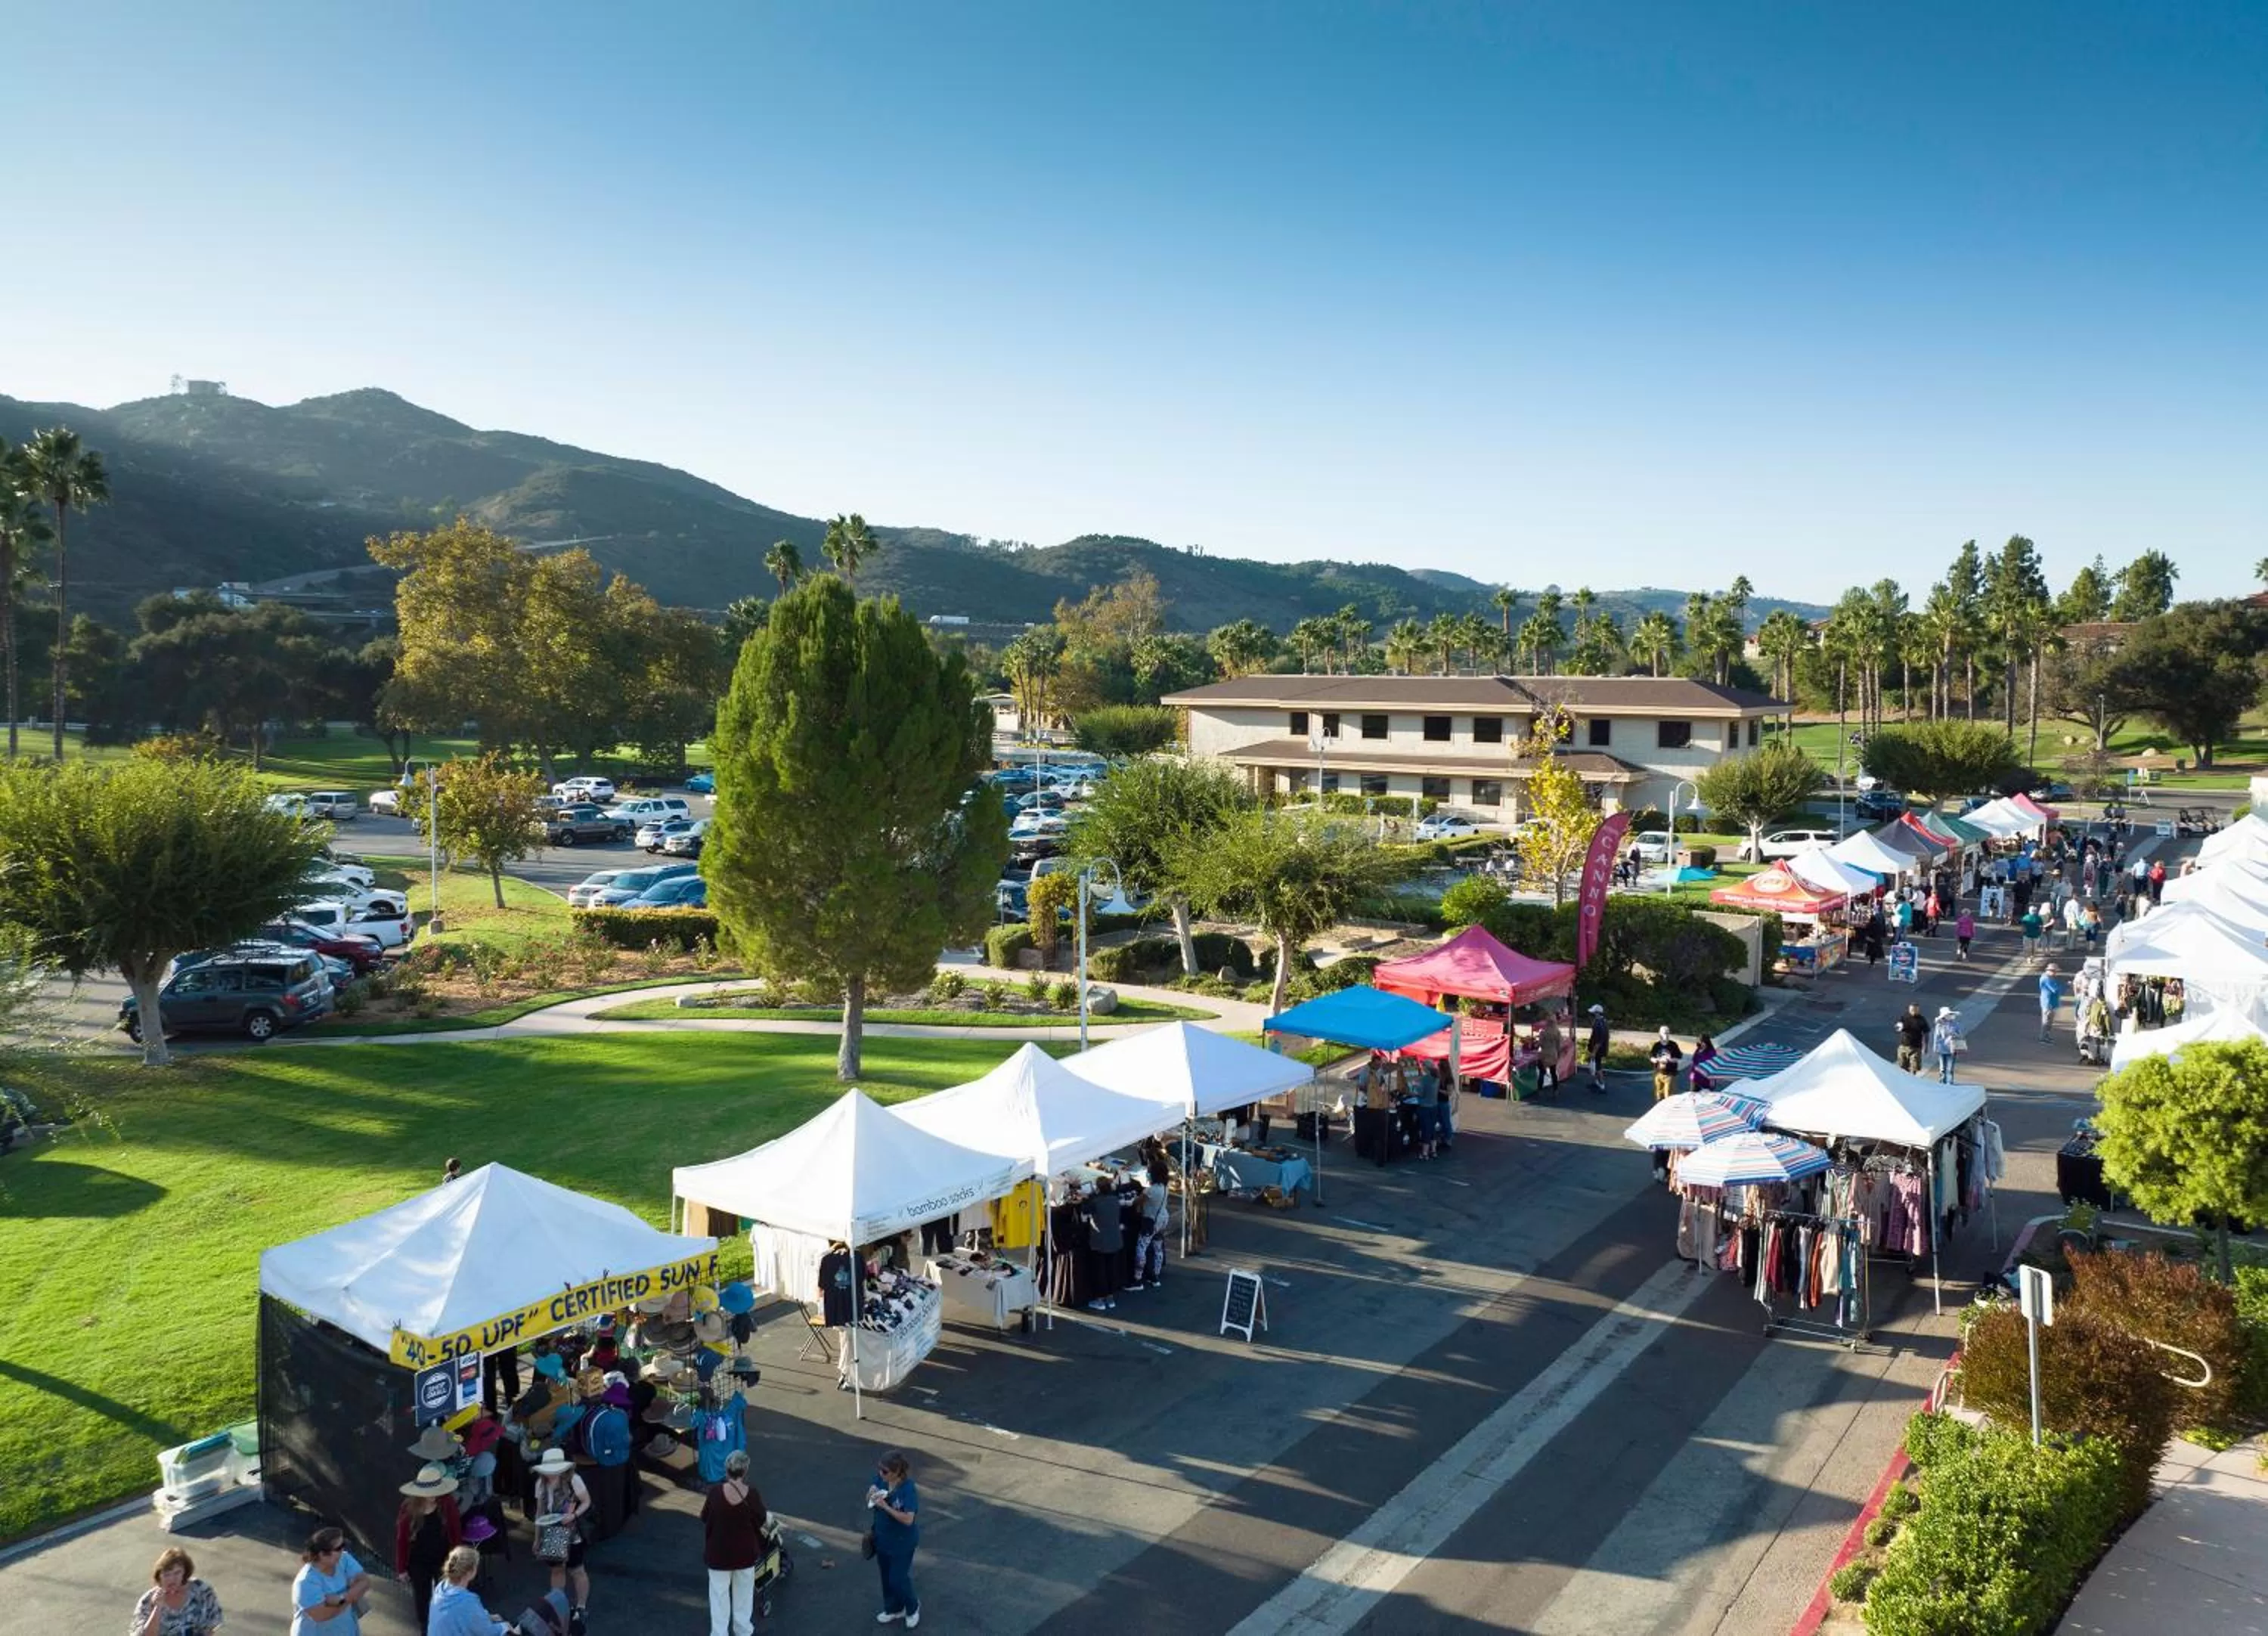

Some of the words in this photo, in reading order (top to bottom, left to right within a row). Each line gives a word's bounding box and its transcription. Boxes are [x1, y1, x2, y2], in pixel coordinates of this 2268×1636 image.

[906, 1196, 949, 1217] bamboo
[550, 1274, 650, 1322] CERTIFIED
[659, 1260, 701, 1291] SUN
